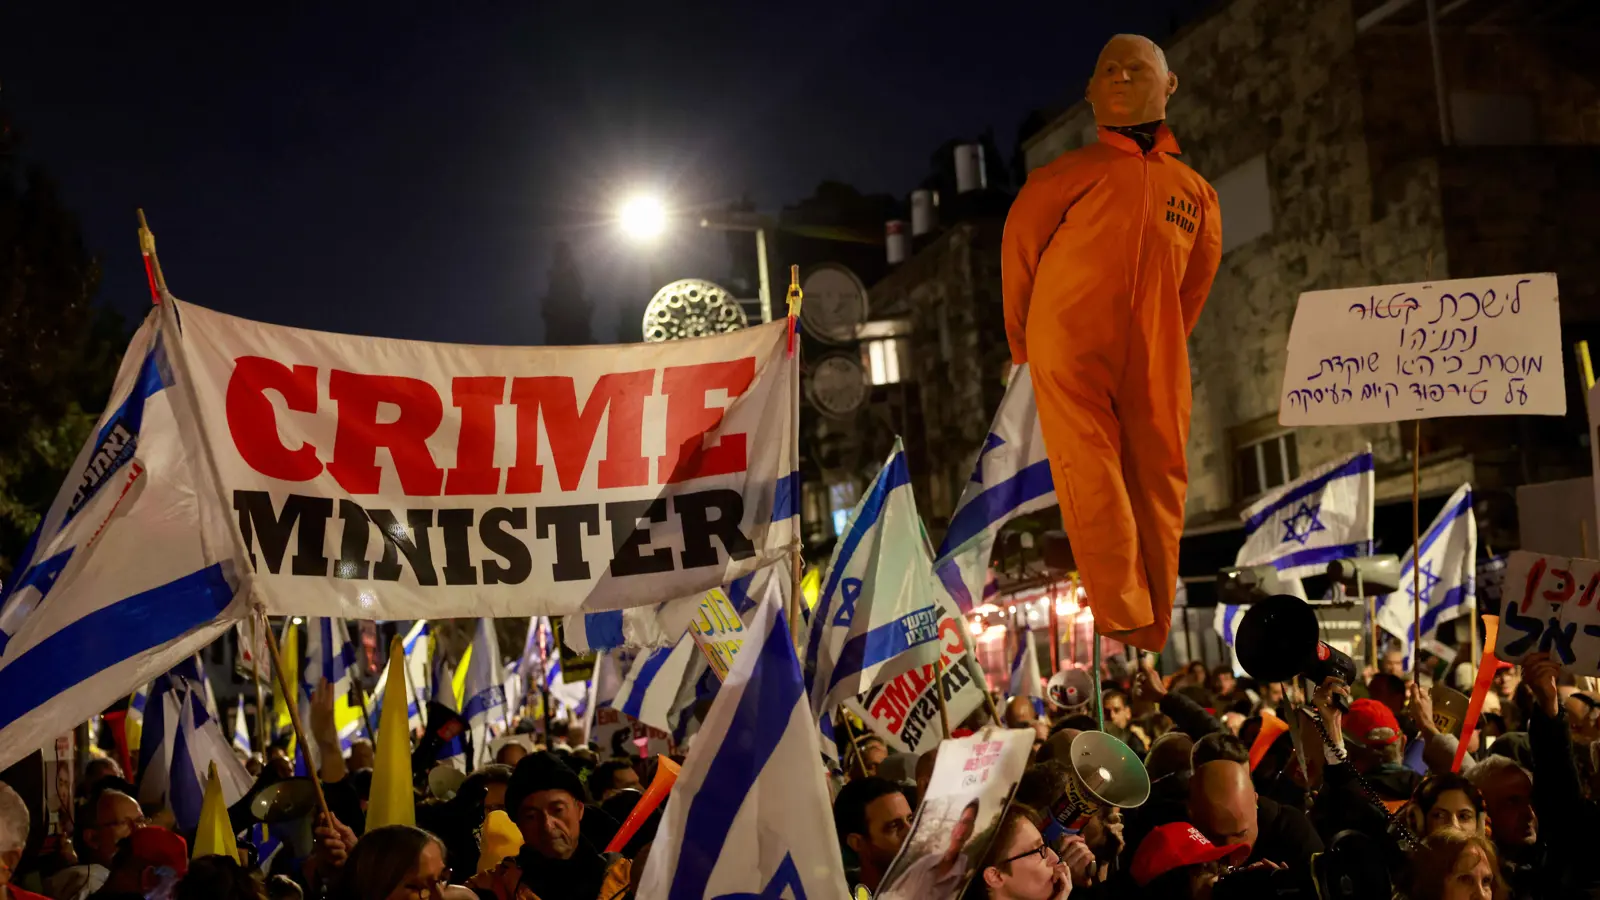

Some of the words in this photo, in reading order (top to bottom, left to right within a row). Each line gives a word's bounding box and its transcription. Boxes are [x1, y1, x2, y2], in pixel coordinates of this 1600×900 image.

[1167, 196, 1199, 219] JAIL
[1166, 210, 1195, 233] BIRD
[1400, 325, 1478, 353] נתניהו
[1397, 355, 1434, 377] היא
[1442, 356, 1463, 372] כי
[1468, 353, 1543, 375] מוסרת
[1504, 378, 1528, 405] על
[225, 355, 756, 496] CRIME
[233, 489, 756, 586] MINISTER
